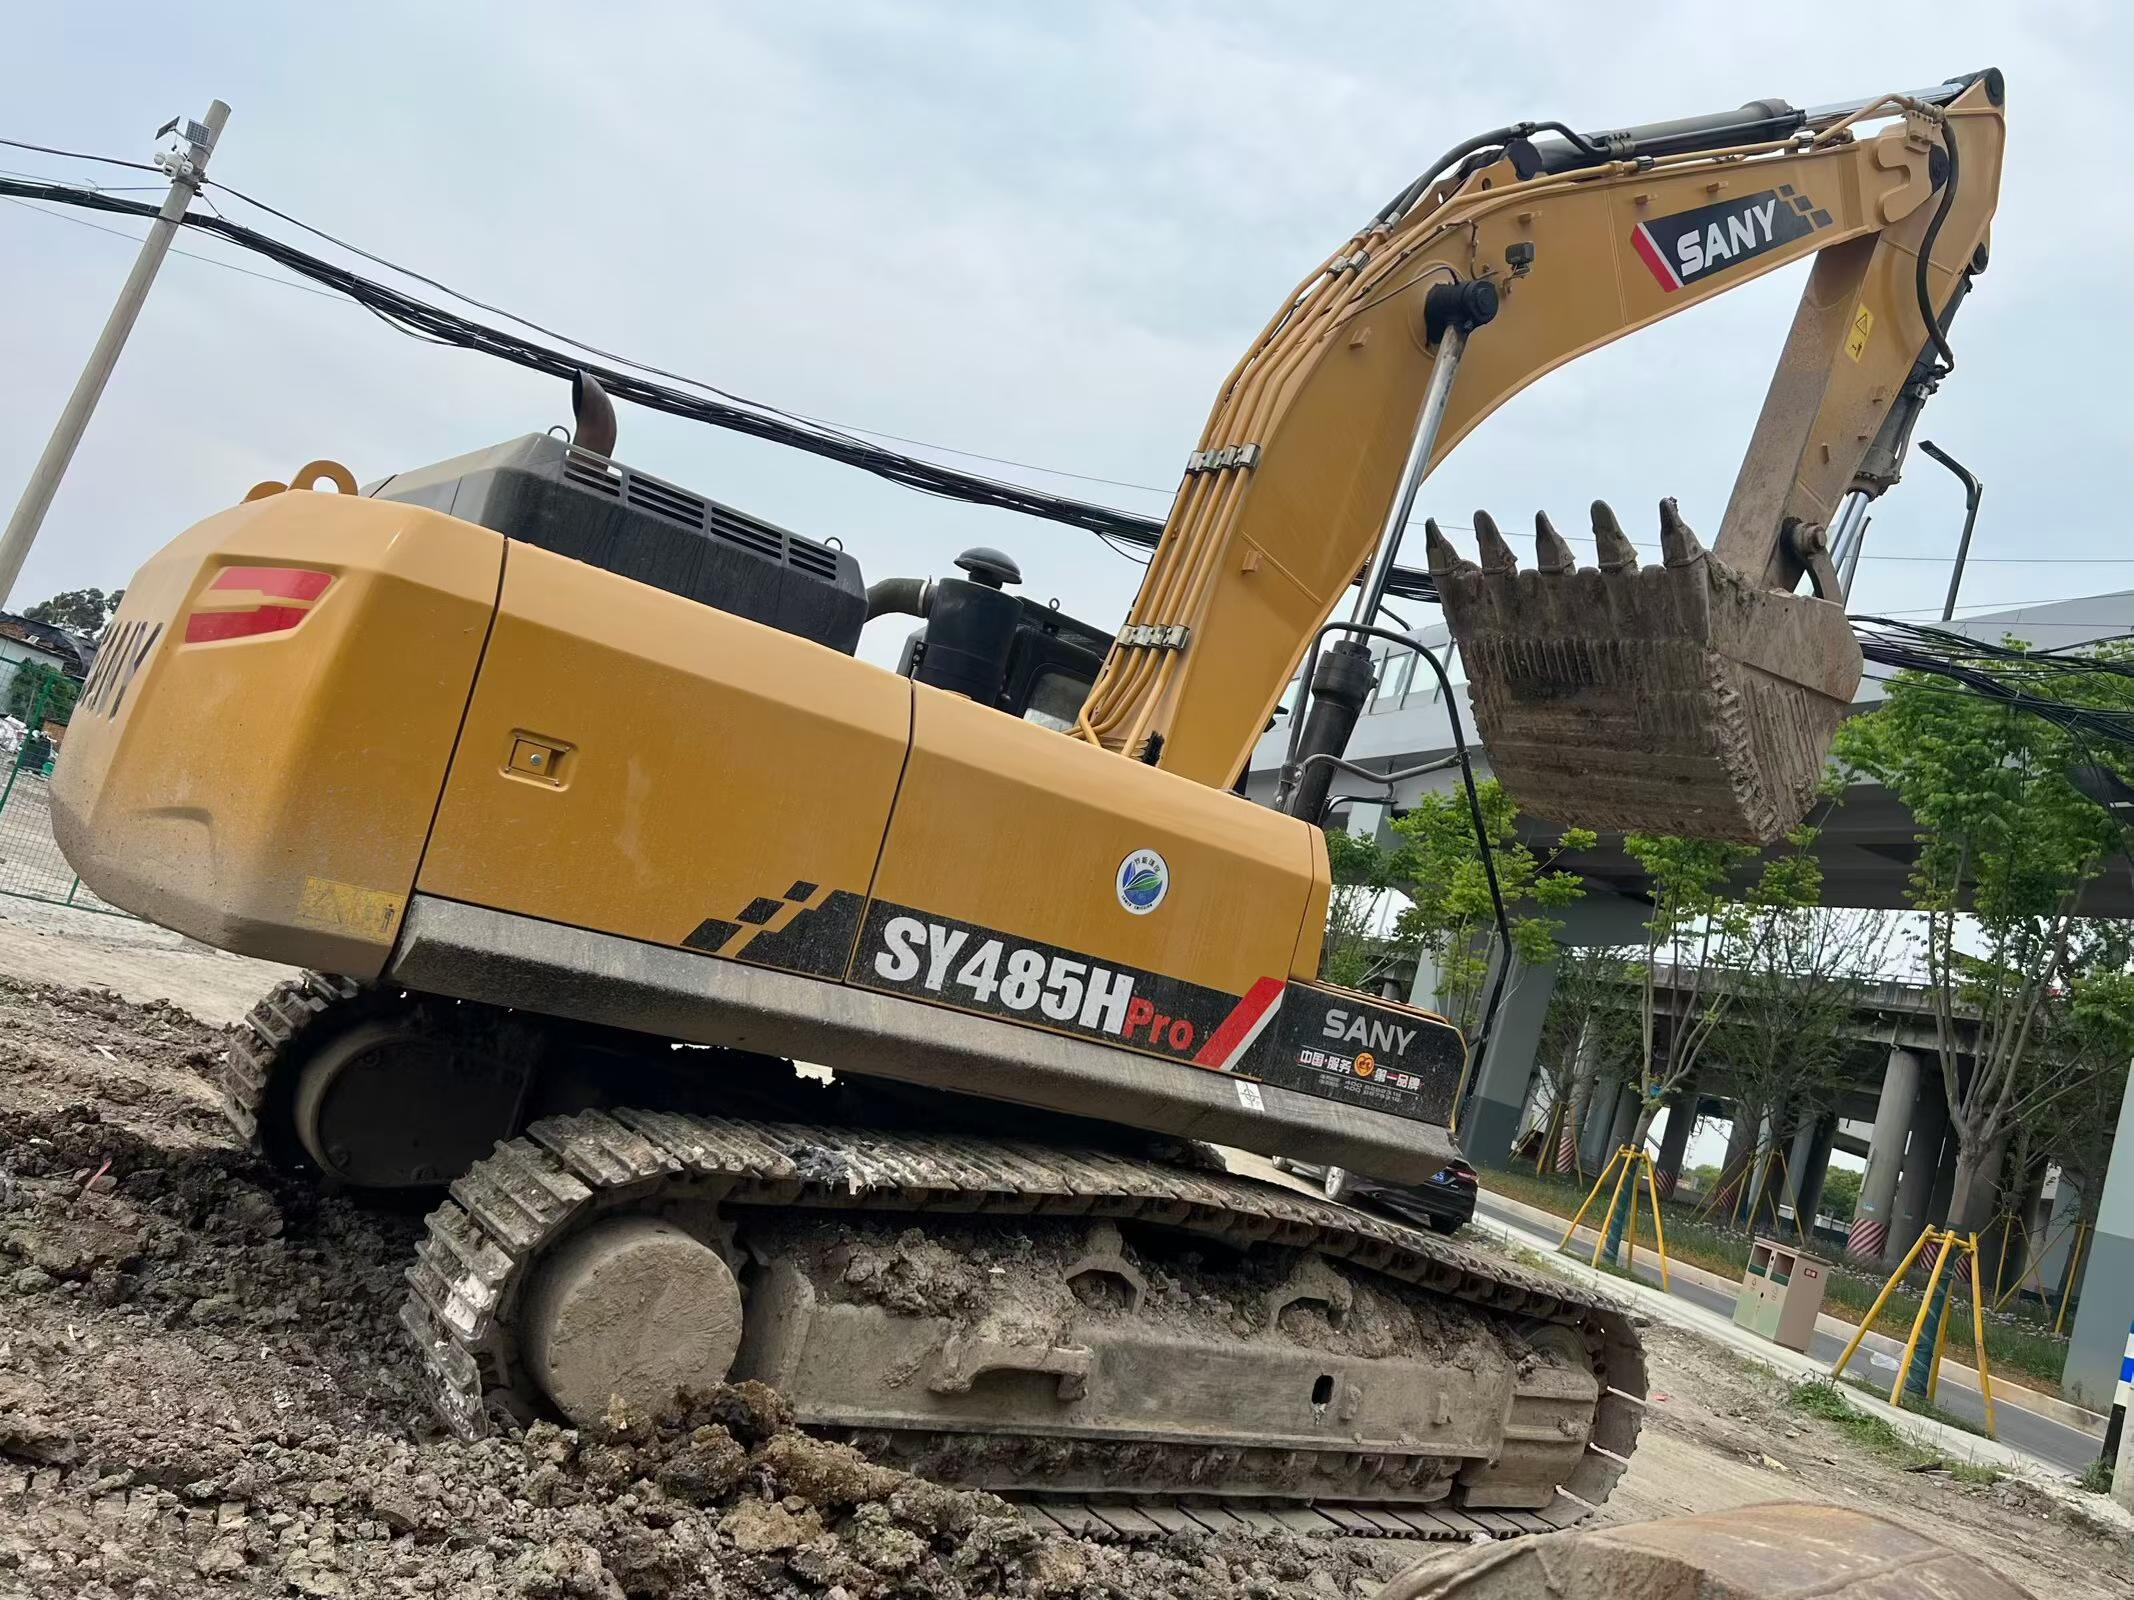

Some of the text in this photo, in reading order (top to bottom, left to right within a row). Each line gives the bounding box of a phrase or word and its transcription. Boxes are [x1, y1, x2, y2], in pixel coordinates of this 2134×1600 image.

[1677, 199, 1776, 277] SANY
[874, 916, 1194, 1050] SY485H Pro
[1322, 1008, 1417, 1056] SANY
[1374, 1068, 1421, 1091] 第一品牌
